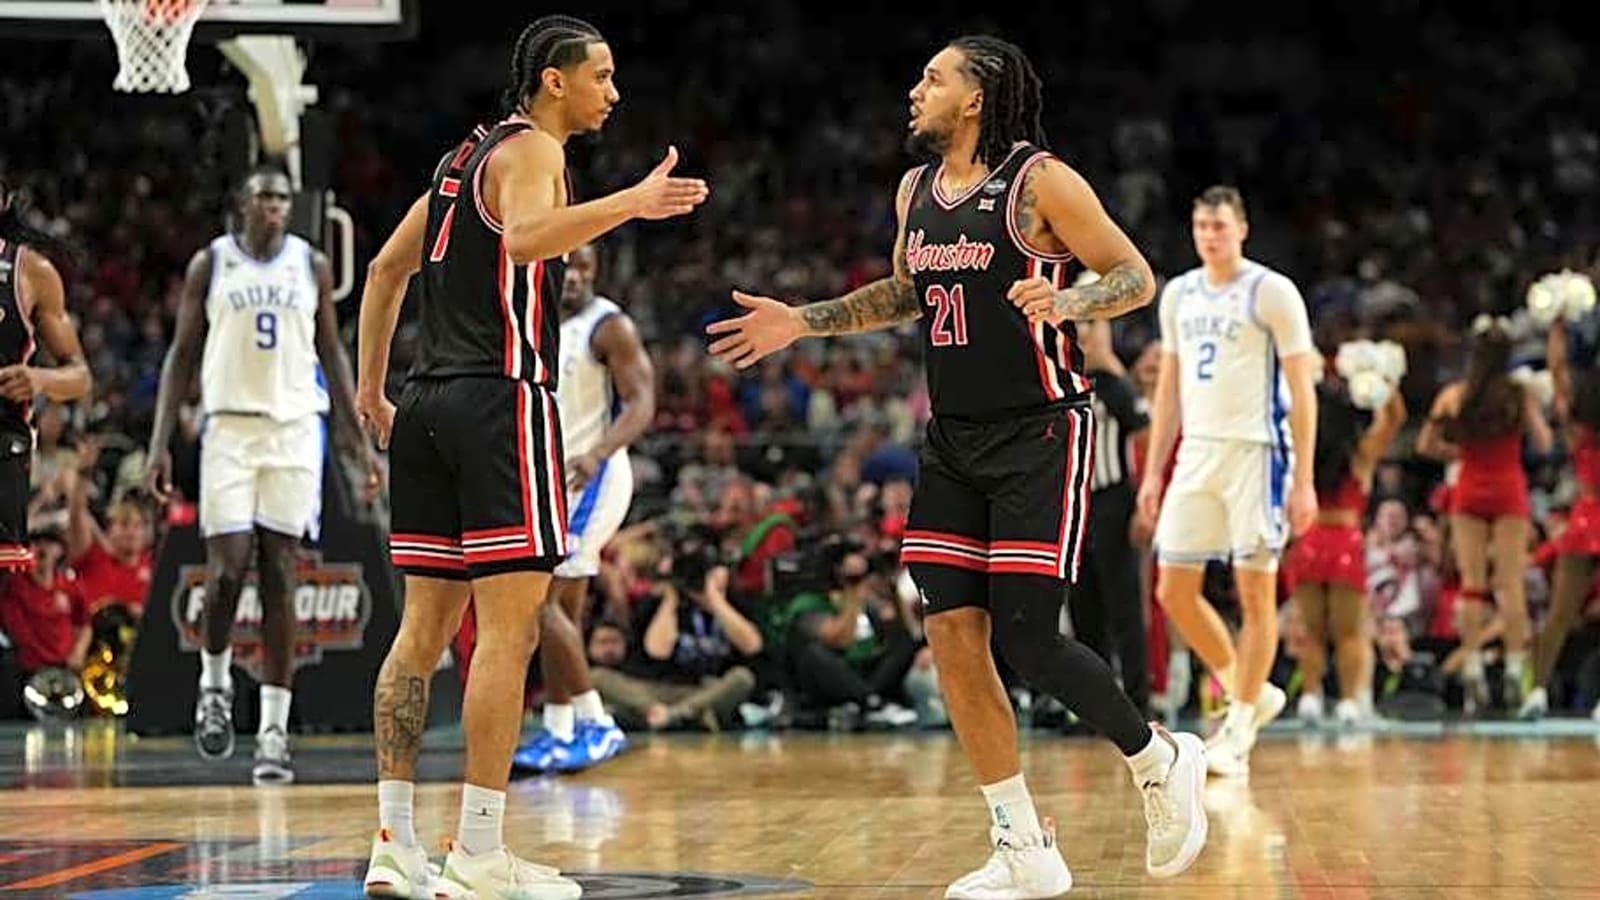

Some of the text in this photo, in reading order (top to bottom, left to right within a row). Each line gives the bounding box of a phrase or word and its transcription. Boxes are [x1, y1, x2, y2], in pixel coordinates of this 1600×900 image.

[907, 229, 995, 275] Houston
[228, 285, 299, 312] DUKE
[925, 284, 968, 346] 21
[256, 312, 277, 350] 9
[1198, 342, 1216, 379] 2
[294, 584, 360, 621] OUR
